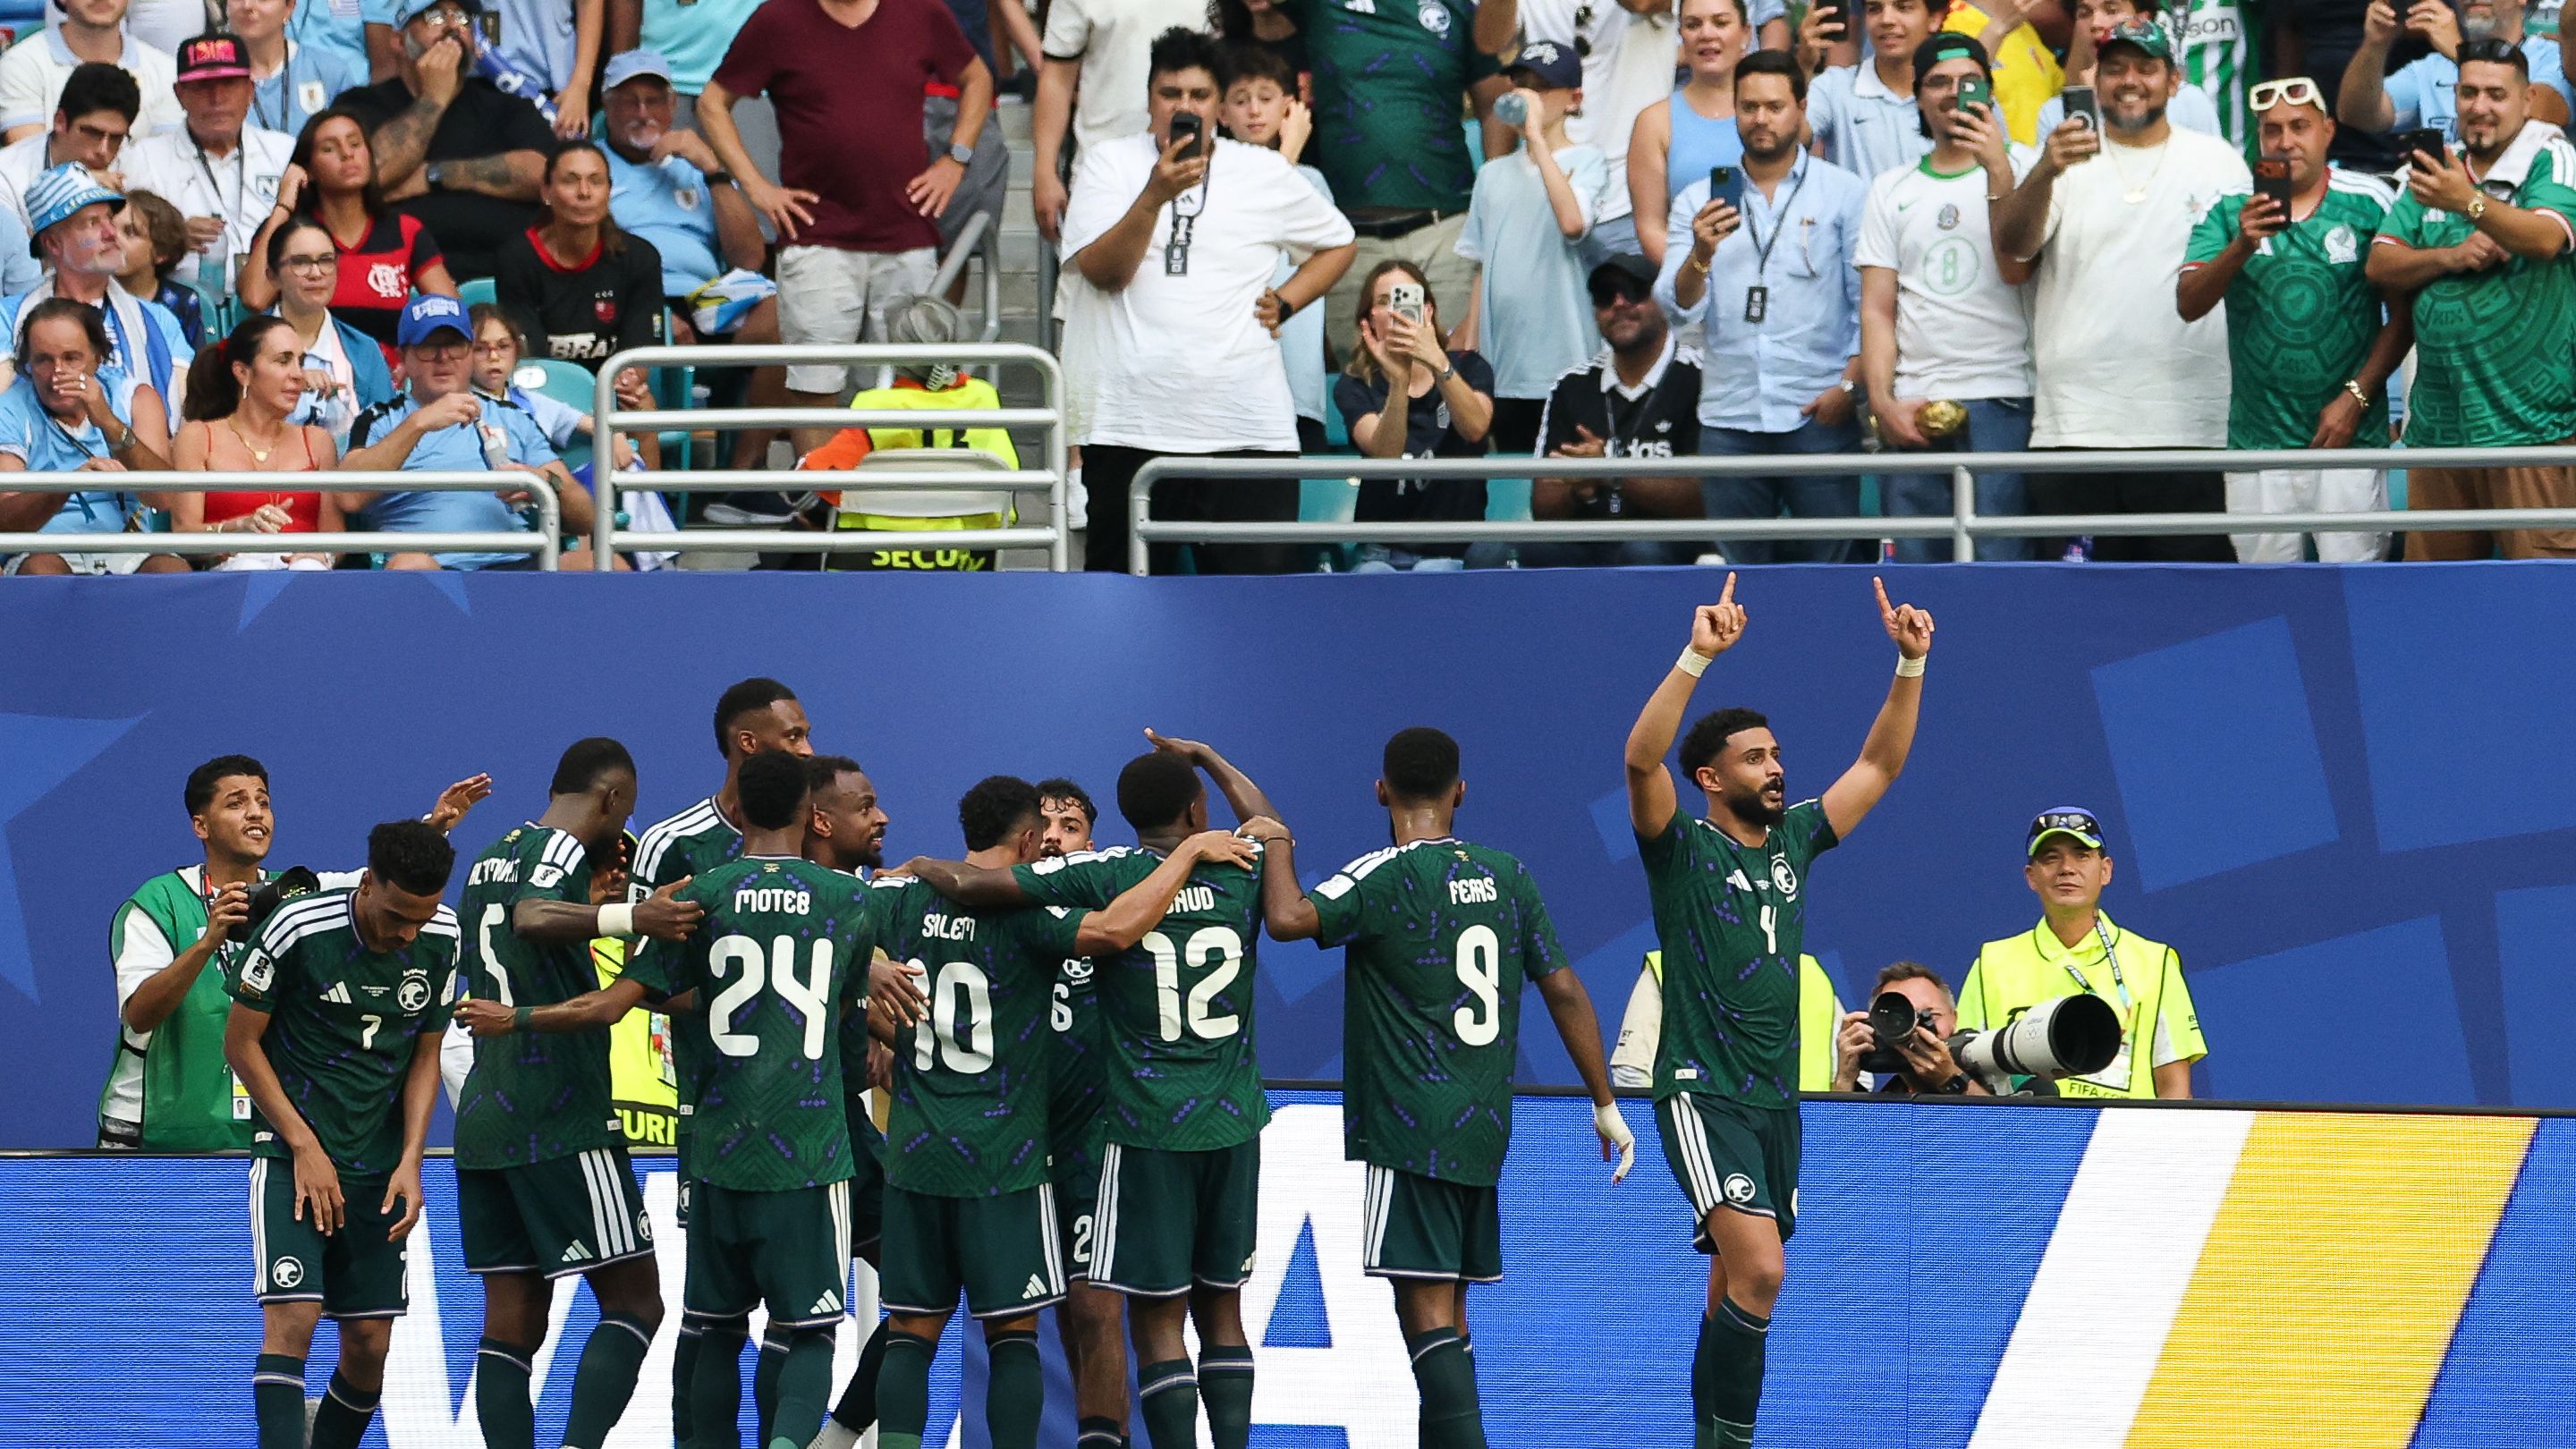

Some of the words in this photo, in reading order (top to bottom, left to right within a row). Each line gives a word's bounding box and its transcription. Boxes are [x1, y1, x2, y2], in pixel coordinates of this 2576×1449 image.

[734, 888, 810, 916] MOTEB
[360, 1014, 381, 1050] 7
[709, 934, 834, 1060] 24
[905, 958, 995, 1073] 10
[1142, 927, 1243, 1042] 12
[1454, 924, 1500, 1046] 9
[614, 1108, 679, 1146] URI
